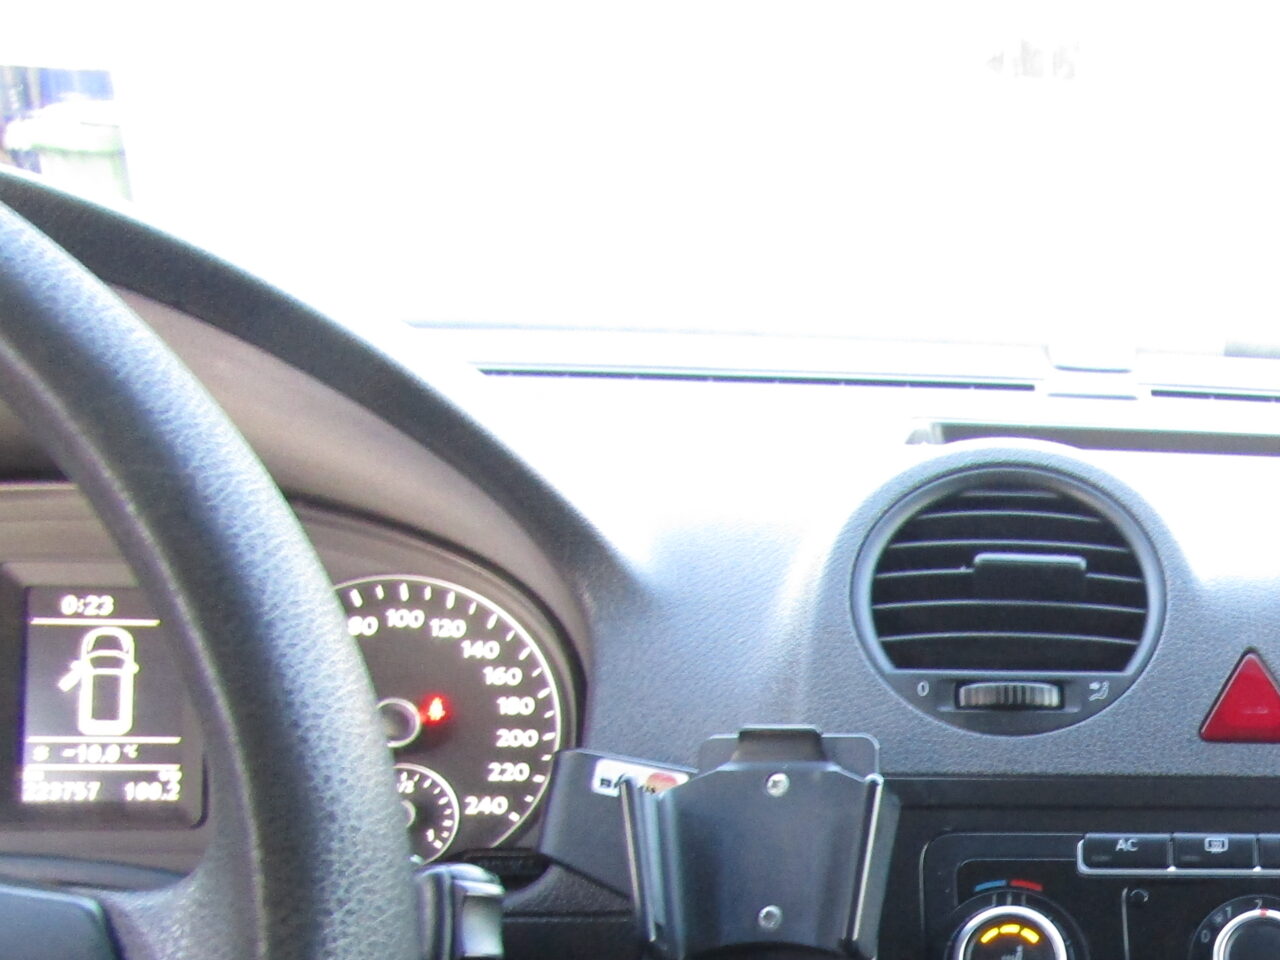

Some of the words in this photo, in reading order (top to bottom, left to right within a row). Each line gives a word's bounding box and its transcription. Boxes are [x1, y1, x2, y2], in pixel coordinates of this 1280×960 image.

[60, 594, 115, 616] 0:23
[347, 615, 379, 637] 80
[385, 608, 425, 629] 100
[429, 618, 466, 639] 120
[460, 639, 501, 660] 140
[482, 666, 523, 686] 160
[495, 695, 536, 716] 180
[495, 728, 540, 748] 200
[487, 762, 531, 782] 220
[464, 795, 509, 815] 240
[1115, 838, 1139, 852] AC
